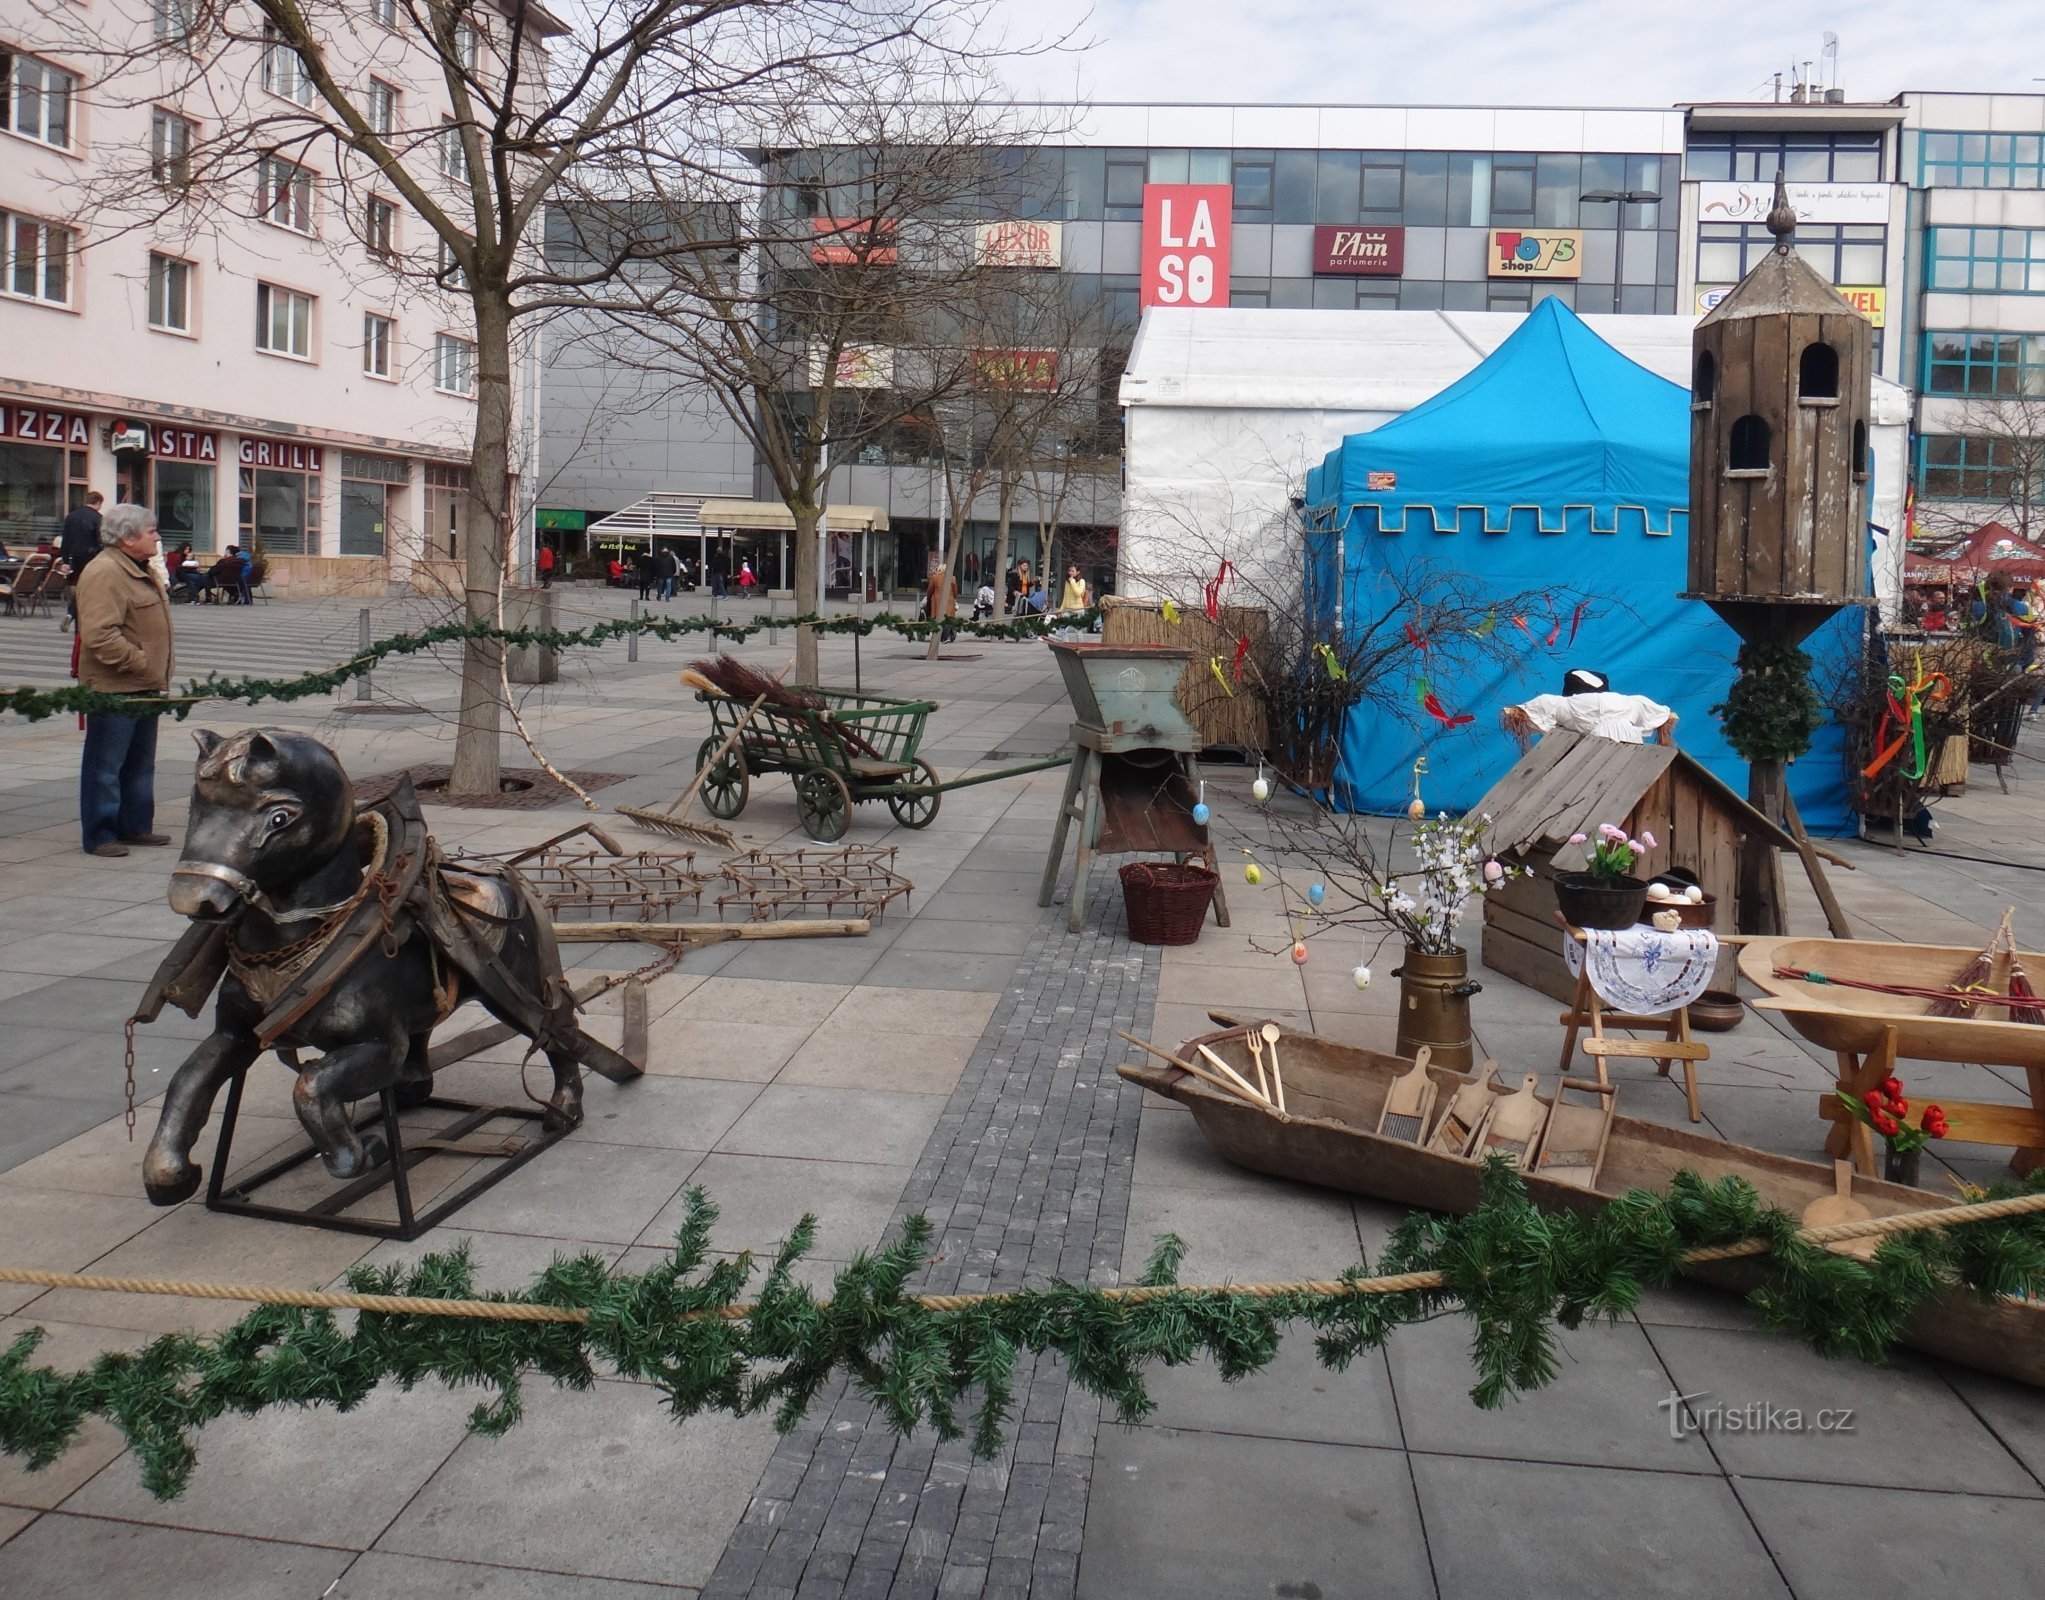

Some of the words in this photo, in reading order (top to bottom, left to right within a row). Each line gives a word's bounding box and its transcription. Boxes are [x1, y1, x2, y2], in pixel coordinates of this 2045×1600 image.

[1160, 199, 1217, 248] LA
[1330, 231, 1388, 257] FAnn
[1330, 257, 1388, 267] parfumerie
[1501, 260, 1534, 272] shop
[1157, 254, 1214, 304] SO
[239, 440, 320, 470] GRILL
